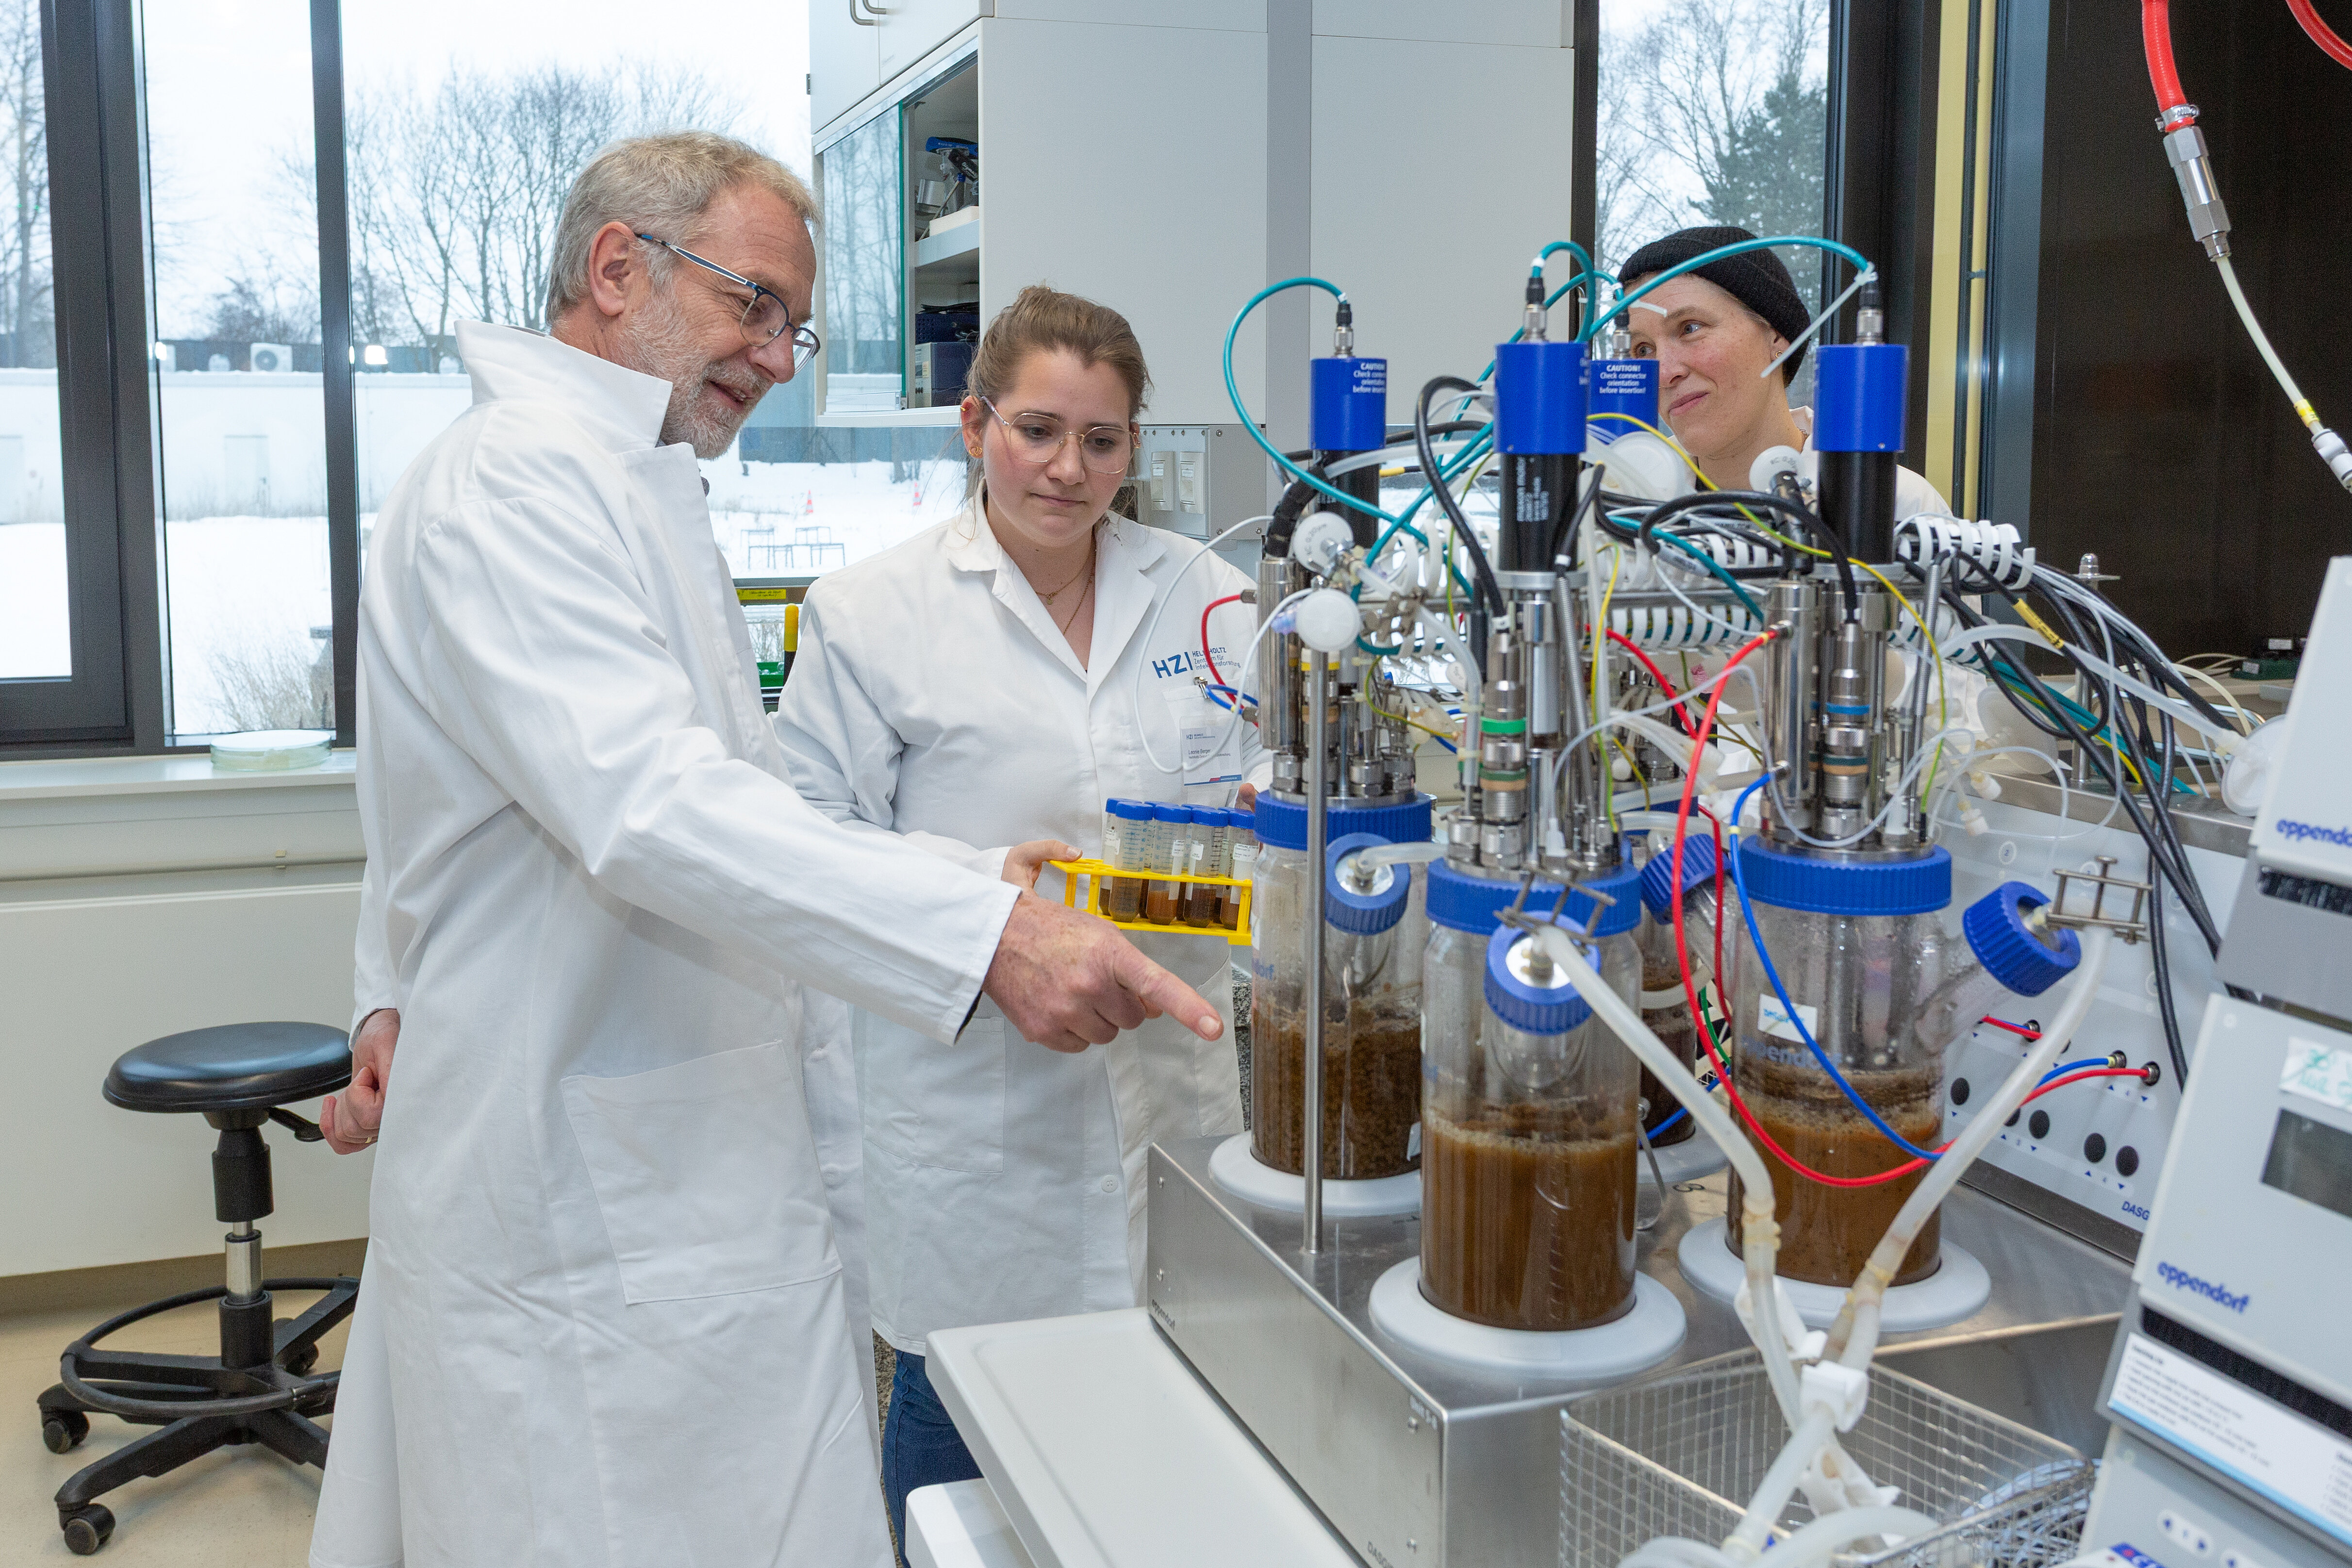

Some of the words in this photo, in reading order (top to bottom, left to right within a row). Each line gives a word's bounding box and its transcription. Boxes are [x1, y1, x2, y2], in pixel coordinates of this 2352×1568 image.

[1192, 647, 1226, 657] HELHOLTZ
[1152, 652, 1193, 678] HZI
[1195, 660, 1241, 670] Infekonsforschung
[2157, 1262, 2250, 1313] eppendorf
